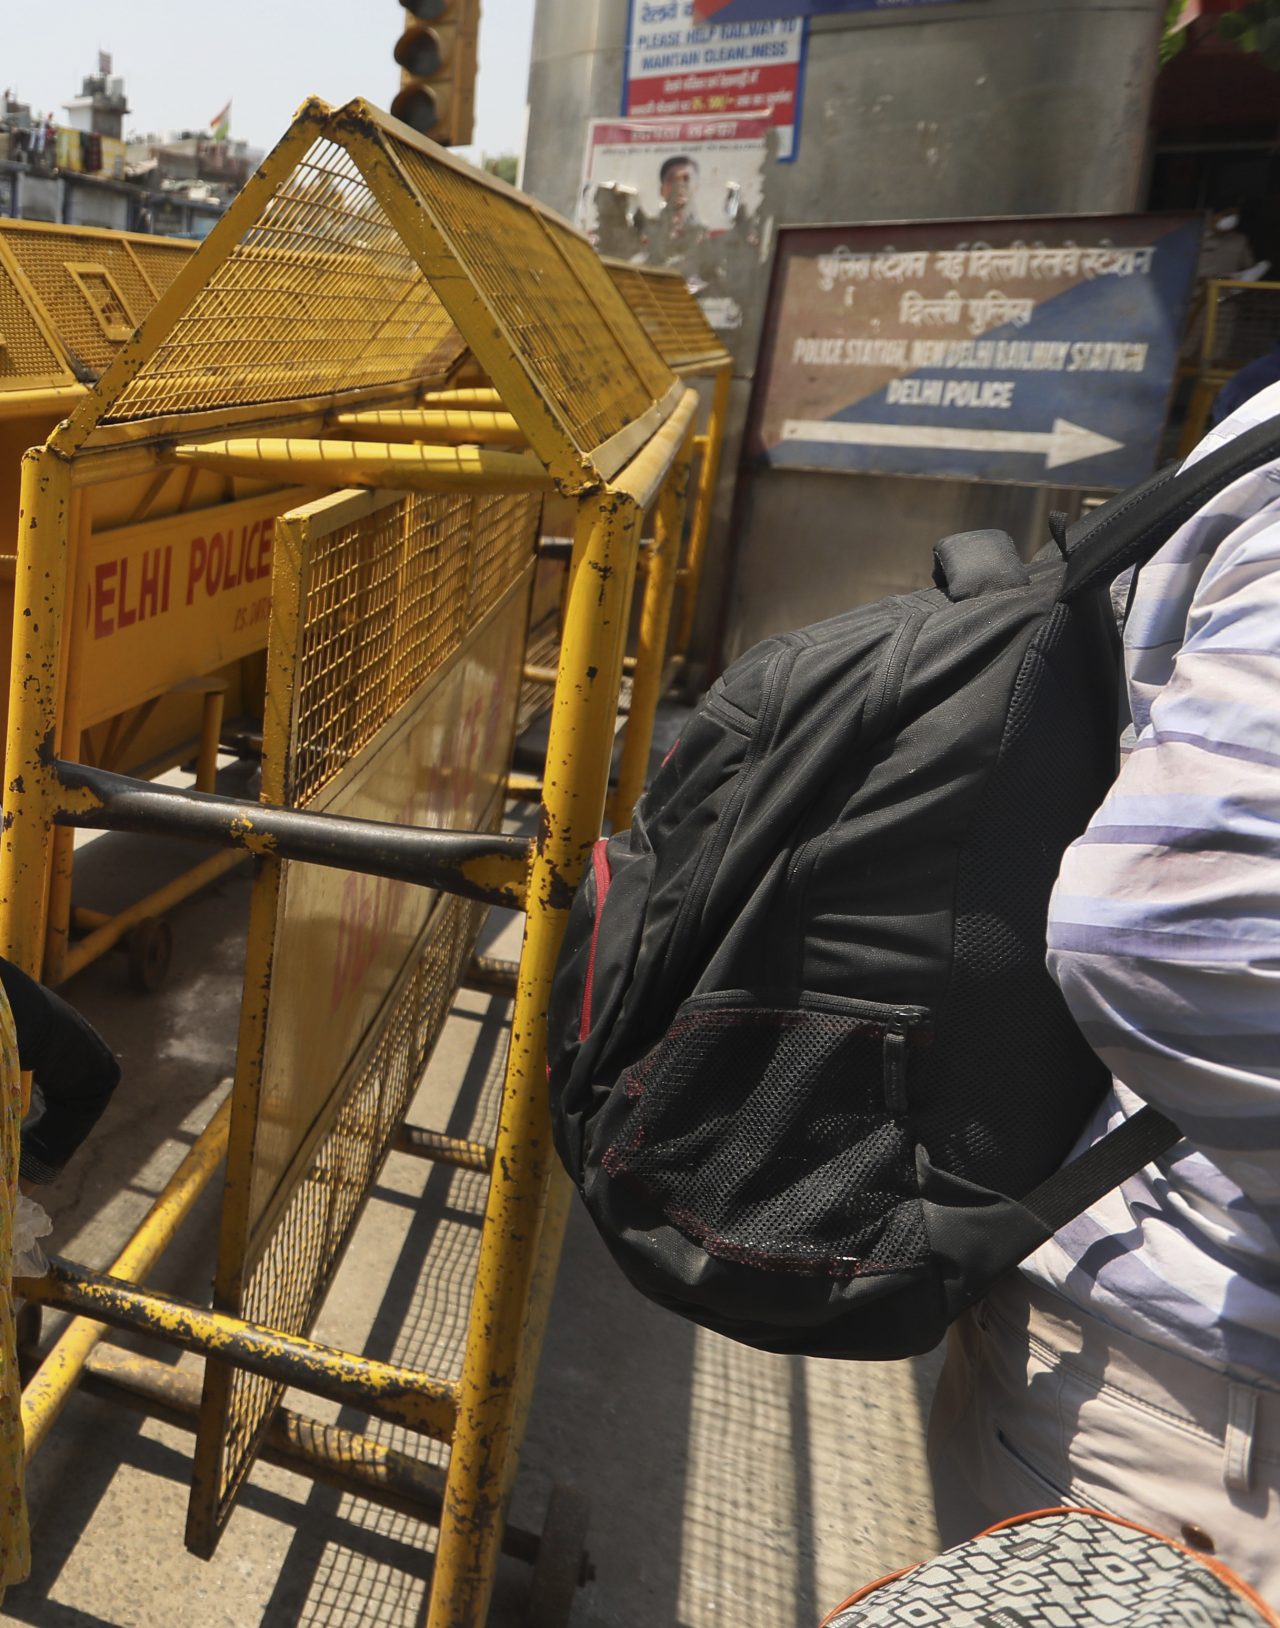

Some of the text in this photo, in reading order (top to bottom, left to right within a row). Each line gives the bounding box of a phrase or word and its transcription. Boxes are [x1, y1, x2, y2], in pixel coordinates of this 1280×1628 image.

[639, 18, 798, 49] PLEASE HELP RAILWAY TO
[642, 41, 788, 70] MAINTAIN CLEANLINESS
[898, 290, 1036, 334] दिल्ली पुलिस
[792, 337, 845, 365] POLICE
[910, 339, 948, 368] NEW
[945, 340, 997, 370] DELHI
[996, 340, 1071, 371] RAILWAY
[1066, 341, 1149, 373] STATION
[885, 378, 1016, 409] DELHI POLICE
[86, 516, 275, 640] ELHI POLICE
